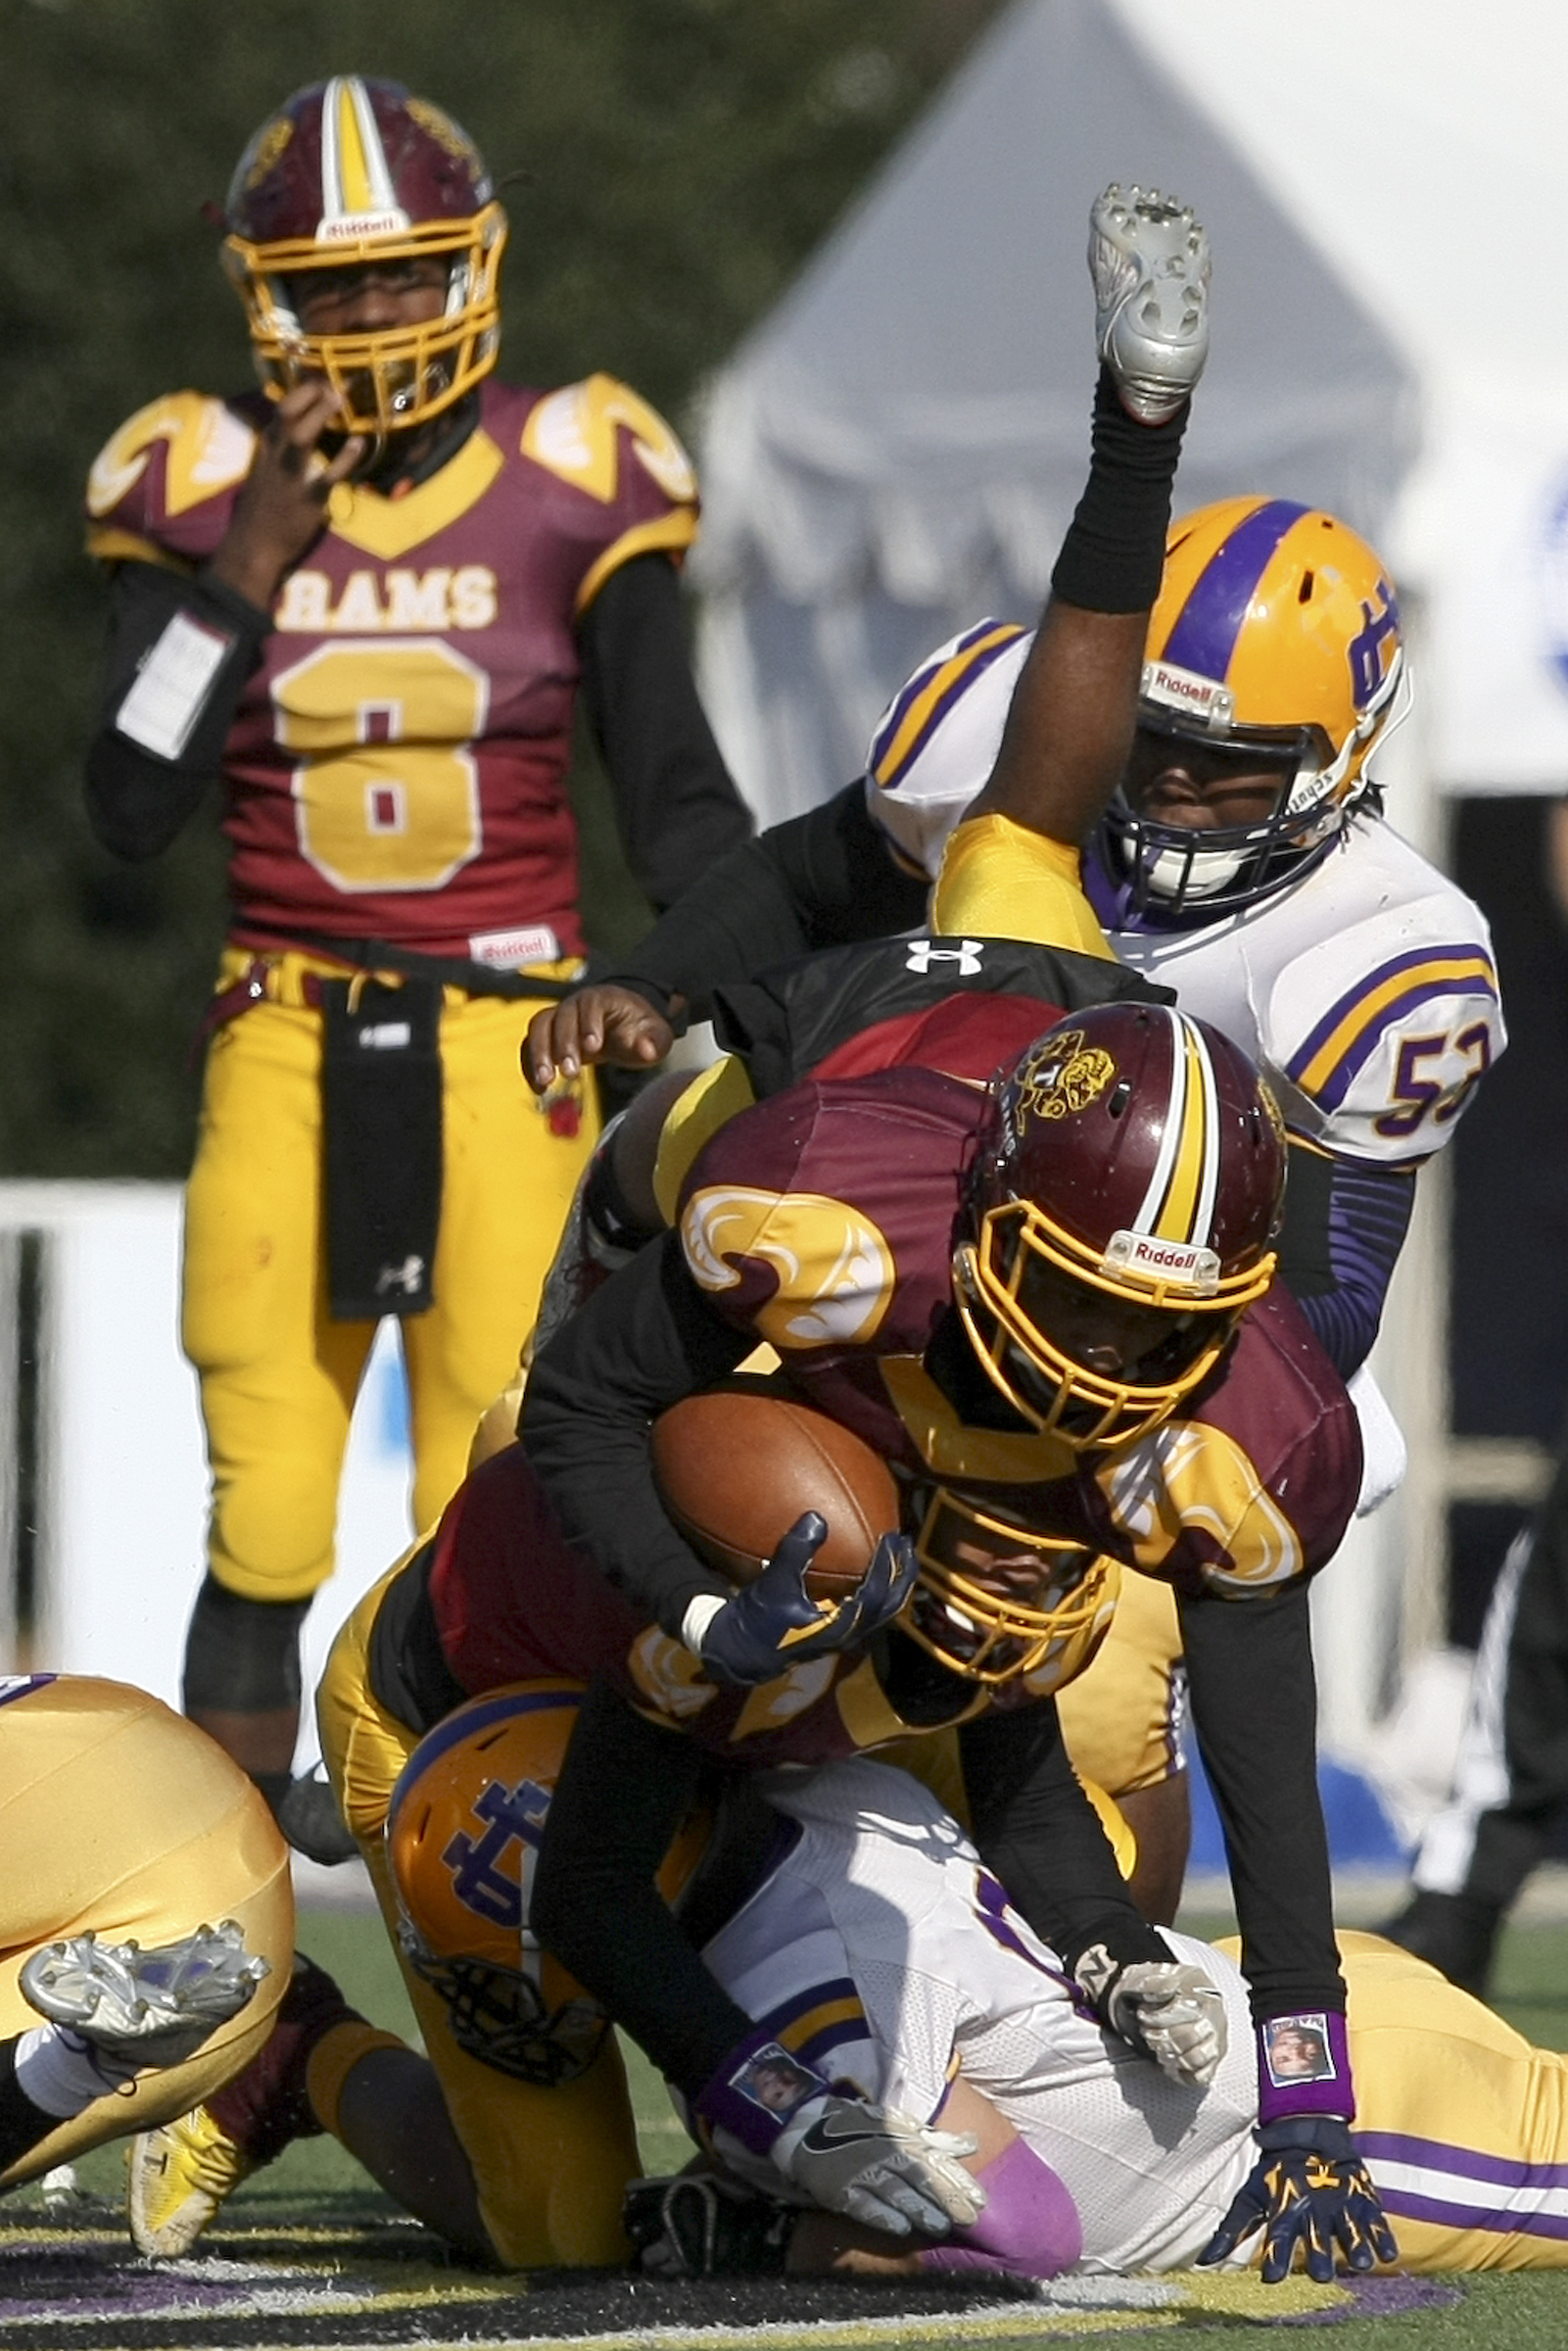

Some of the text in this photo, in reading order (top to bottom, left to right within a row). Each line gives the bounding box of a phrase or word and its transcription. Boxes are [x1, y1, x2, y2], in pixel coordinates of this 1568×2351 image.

[274, 564, 498, 633] RAMS
[1155, 669, 1212, 703] Riddell
[269, 637, 491, 894] 8
[1370, 1017, 1490, 1140] 53
[1136, 1241, 1197, 1270] Riddell
